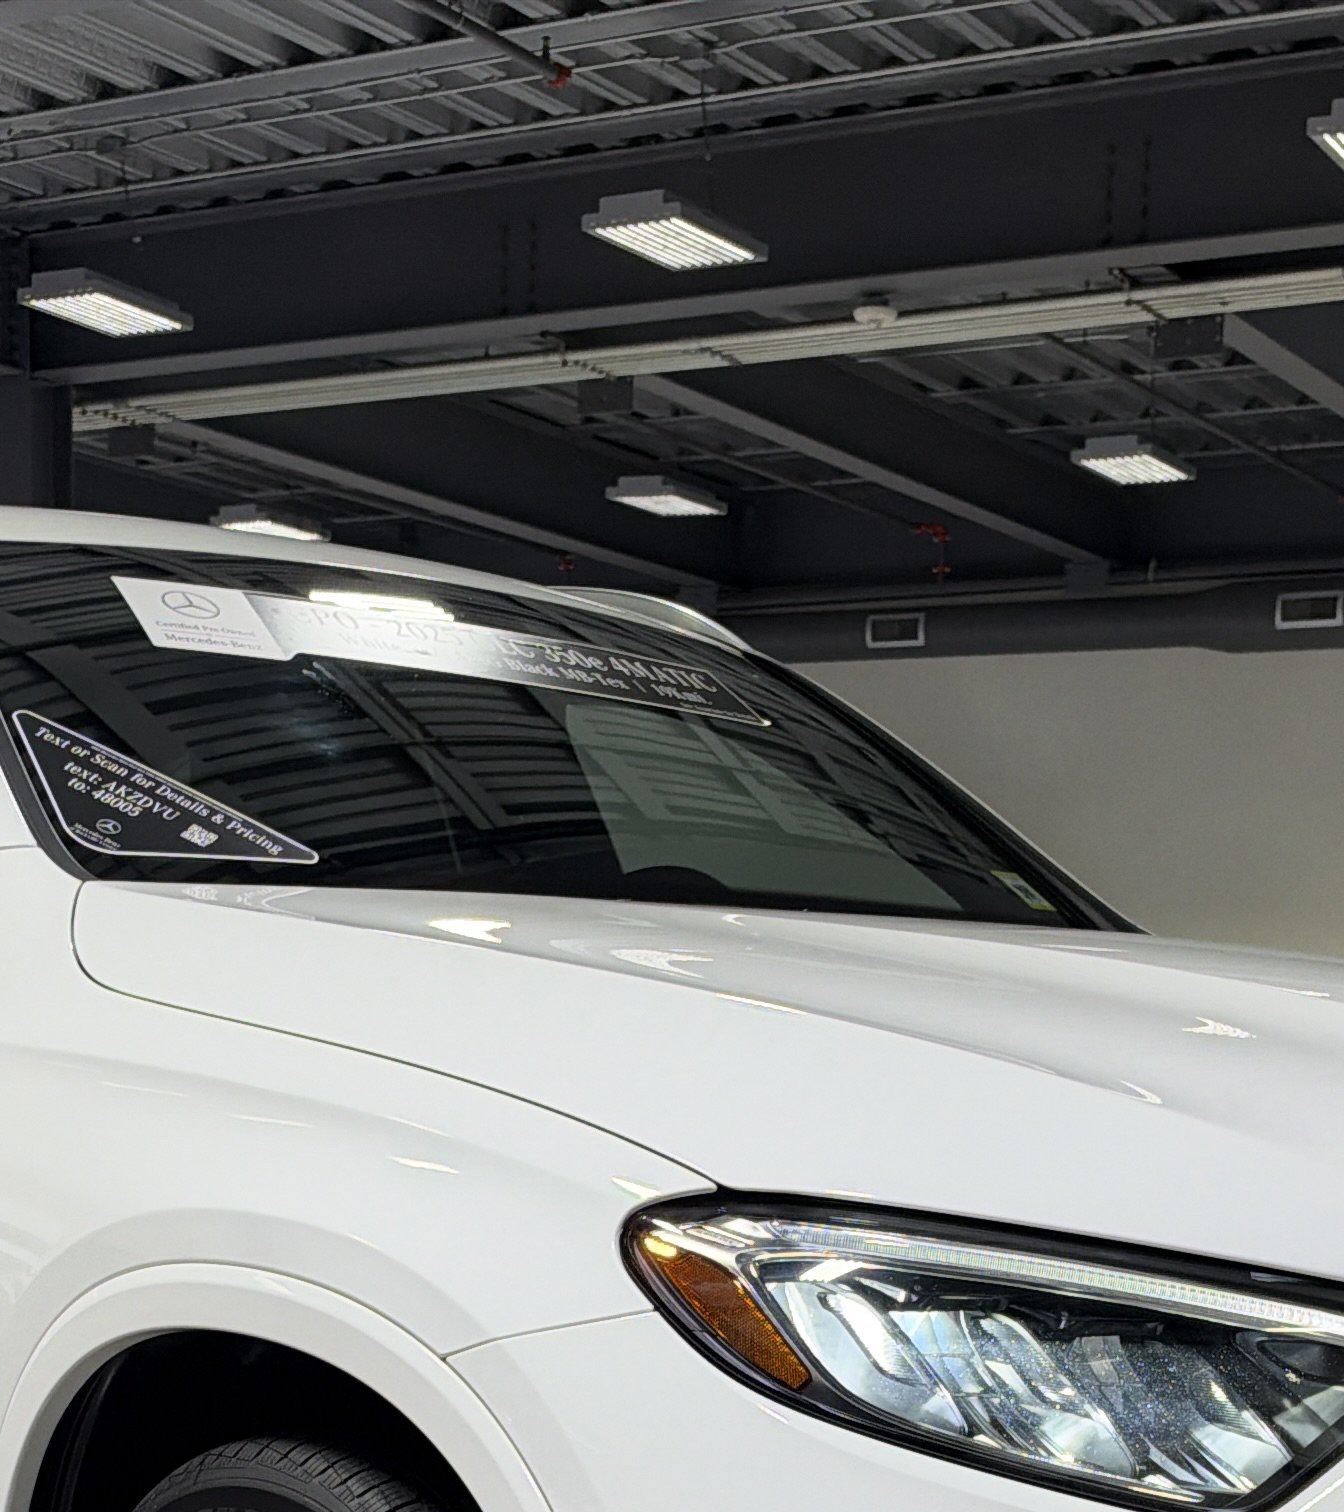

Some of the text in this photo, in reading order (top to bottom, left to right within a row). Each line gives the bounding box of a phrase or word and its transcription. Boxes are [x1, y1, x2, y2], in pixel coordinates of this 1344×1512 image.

[536, 644, 610, 674] 350e
[608, 655, 718, 694] 4MATIC
[35, 726, 285, 857] Text or Scan for Details & Pricing
[64, 761, 181, 822] text: AKZDVU
[67, 776, 144, 818] to: 48005
